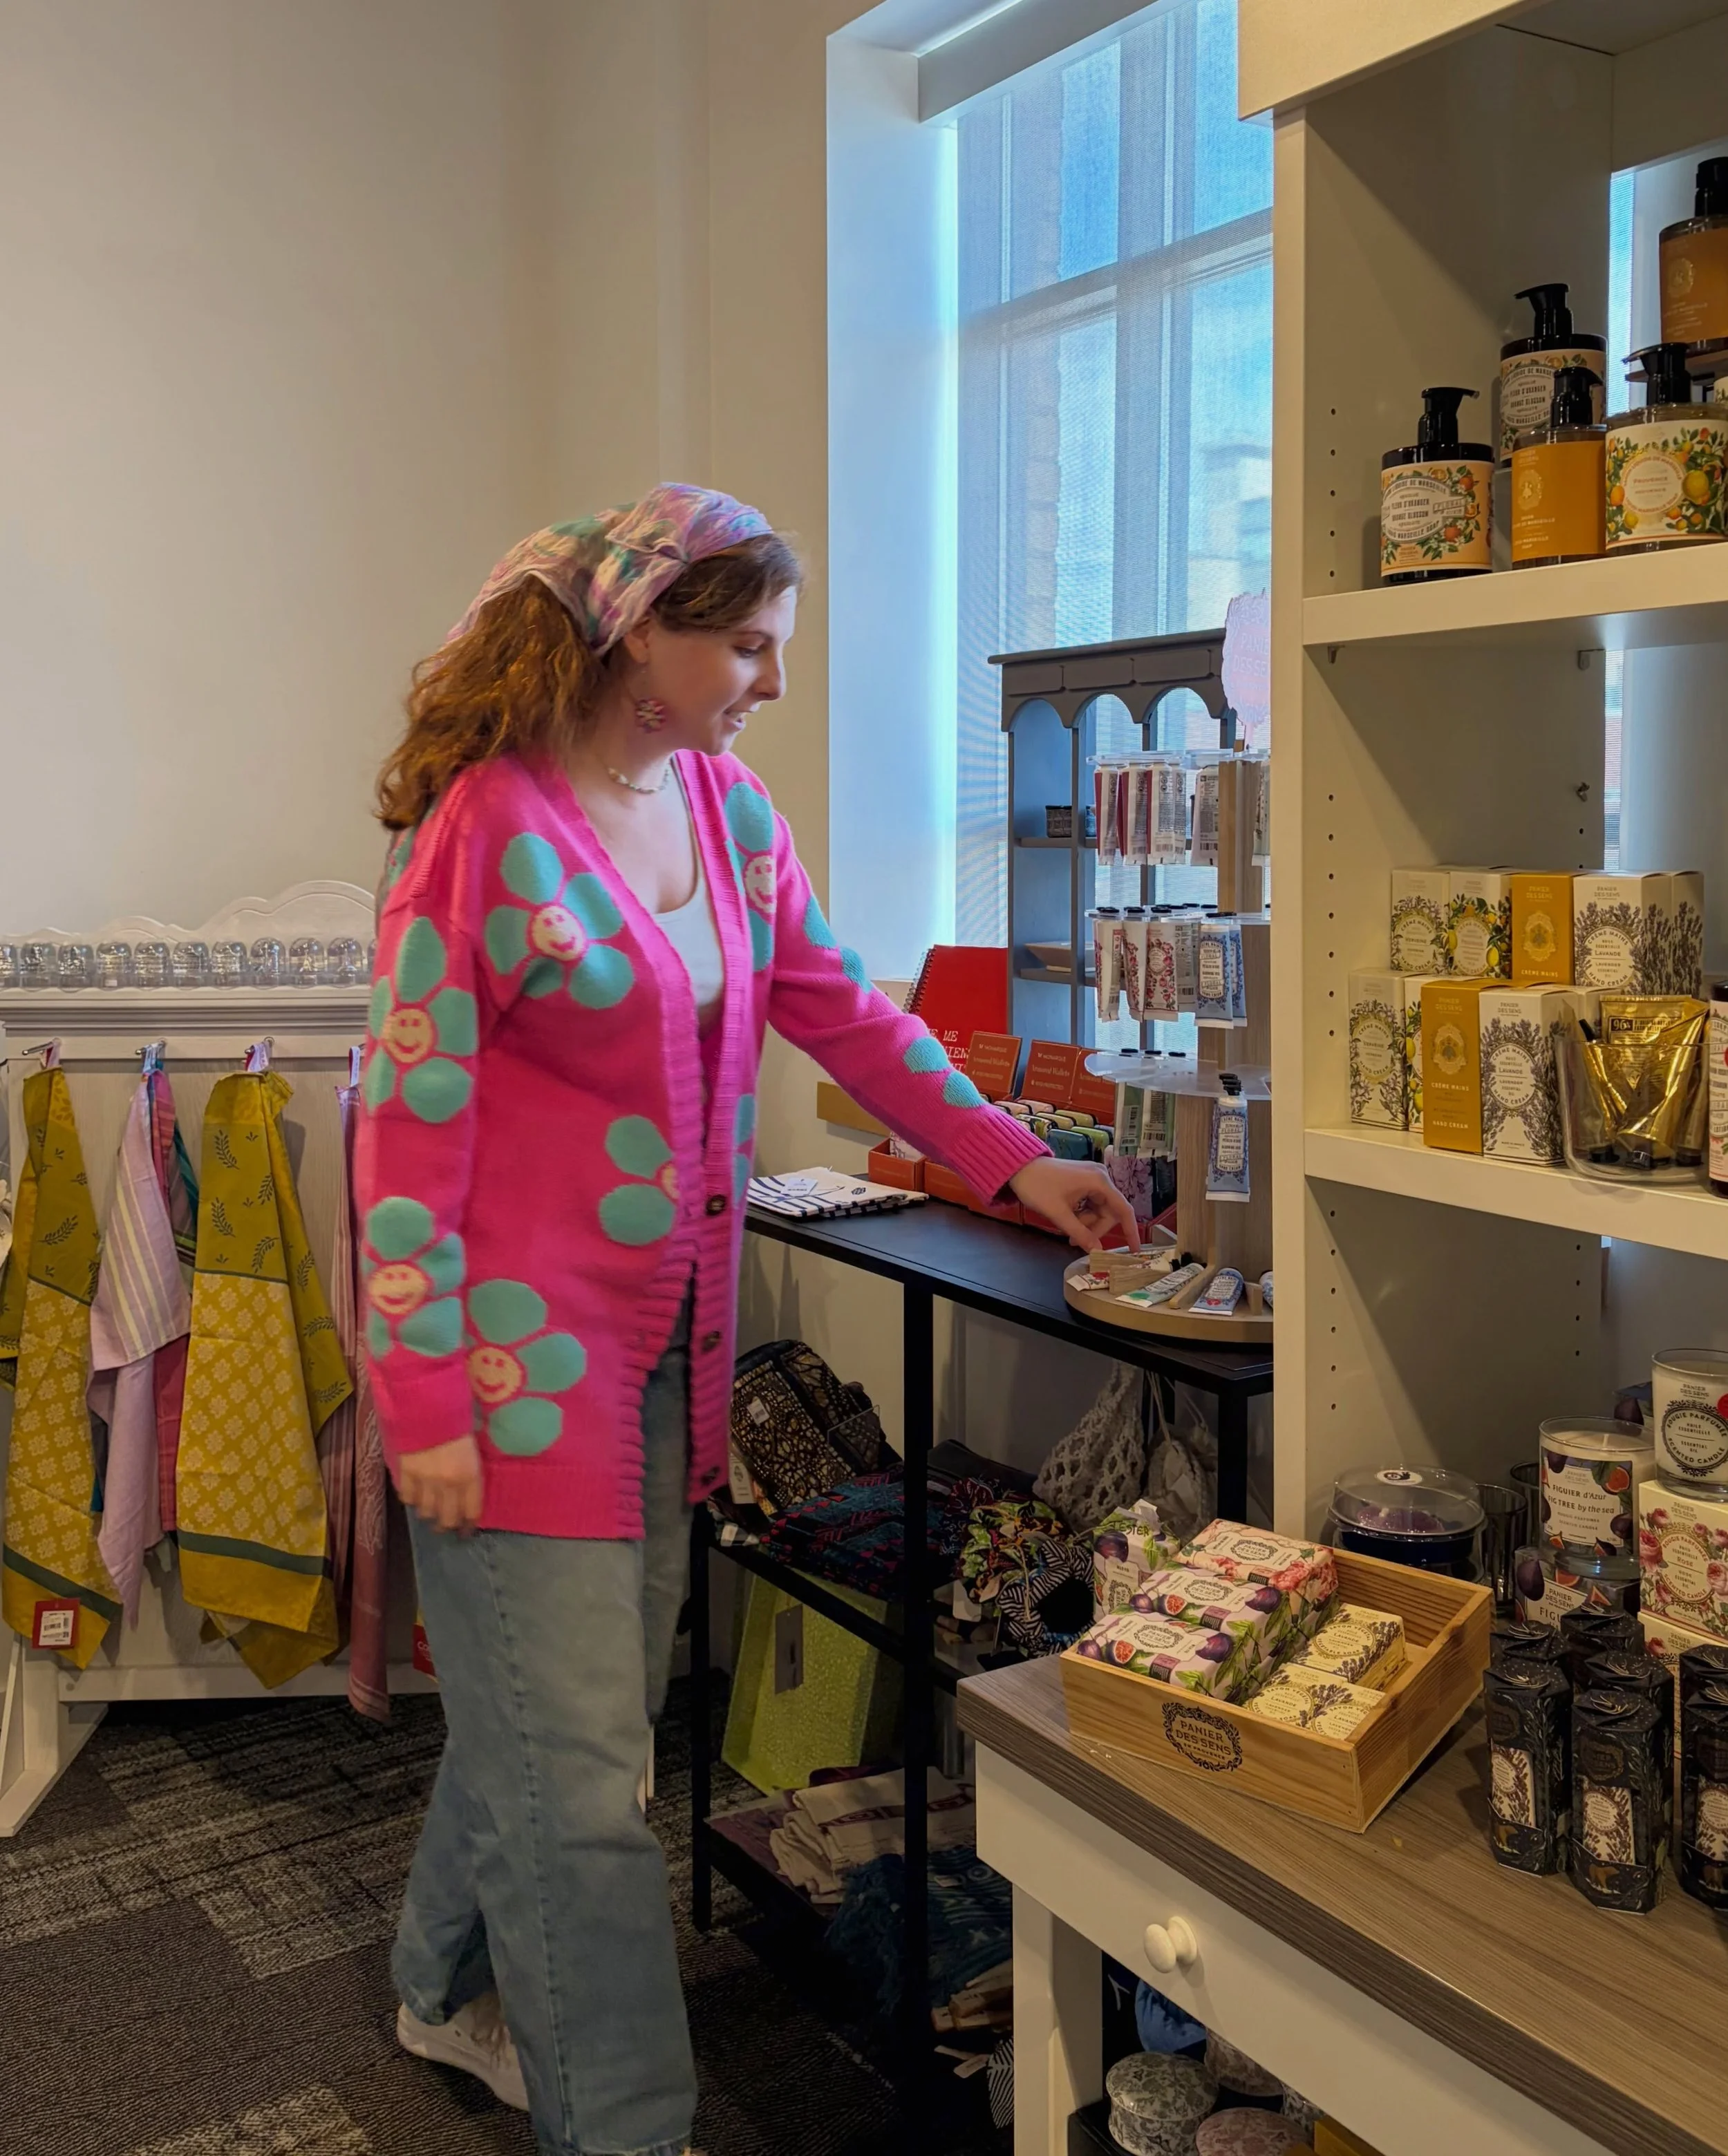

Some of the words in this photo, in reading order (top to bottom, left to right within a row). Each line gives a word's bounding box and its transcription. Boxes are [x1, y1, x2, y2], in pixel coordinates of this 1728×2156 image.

[1241, 632, 1270, 655] PANIE
[1233, 654, 1252, 675] DES
[1255, 660, 1270, 677] SE
[1588, 930, 1607, 944] CRÈME
[1609, 930, 1628, 946] MAINS
[943, 1030, 959, 1042] ME
[1492, 1047, 1510, 1061] CRÈME
[1512, 1048, 1530, 1063] MAINS
[1494, 1089, 1509, 1104] HAND
[1510, 1093, 1529, 1105] CREAM
[1666, 1412, 1688, 1428] BOUGIE
[1667, 1437, 1695, 1463] SCENTED
[1697, 1446, 1725, 1464] CANDLE
[1681, 1440, 1708, 1450] ESSENTIAL
[1552, 1484, 1581, 1497] FIGUIER
[1583, 1492, 1607, 1500] d'Azur
[1548, 1495, 1557, 1504] FIG
[1558, 1498, 1576, 1509] TREE
[1577, 1504, 1587, 1513] by
[1677, 1556, 1693, 1567] ROSE
[1664, 1573, 1687, 1597] SCENTED
[1687, 1589, 1707, 1600] CANDLE
[1546, 1594, 1558, 1604] DES
[1549, 1588, 1572, 1602] PANIER
[1270, 1696, 1297, 1708] LAVANDE
[1334, 1714, 1359, 1725] LAVAND
[1180, 1719, 1223, 1743] PANIER
[1175, 1729, 1199, 1744] DES
[1200, 1738, 1232, 1756] SENS
